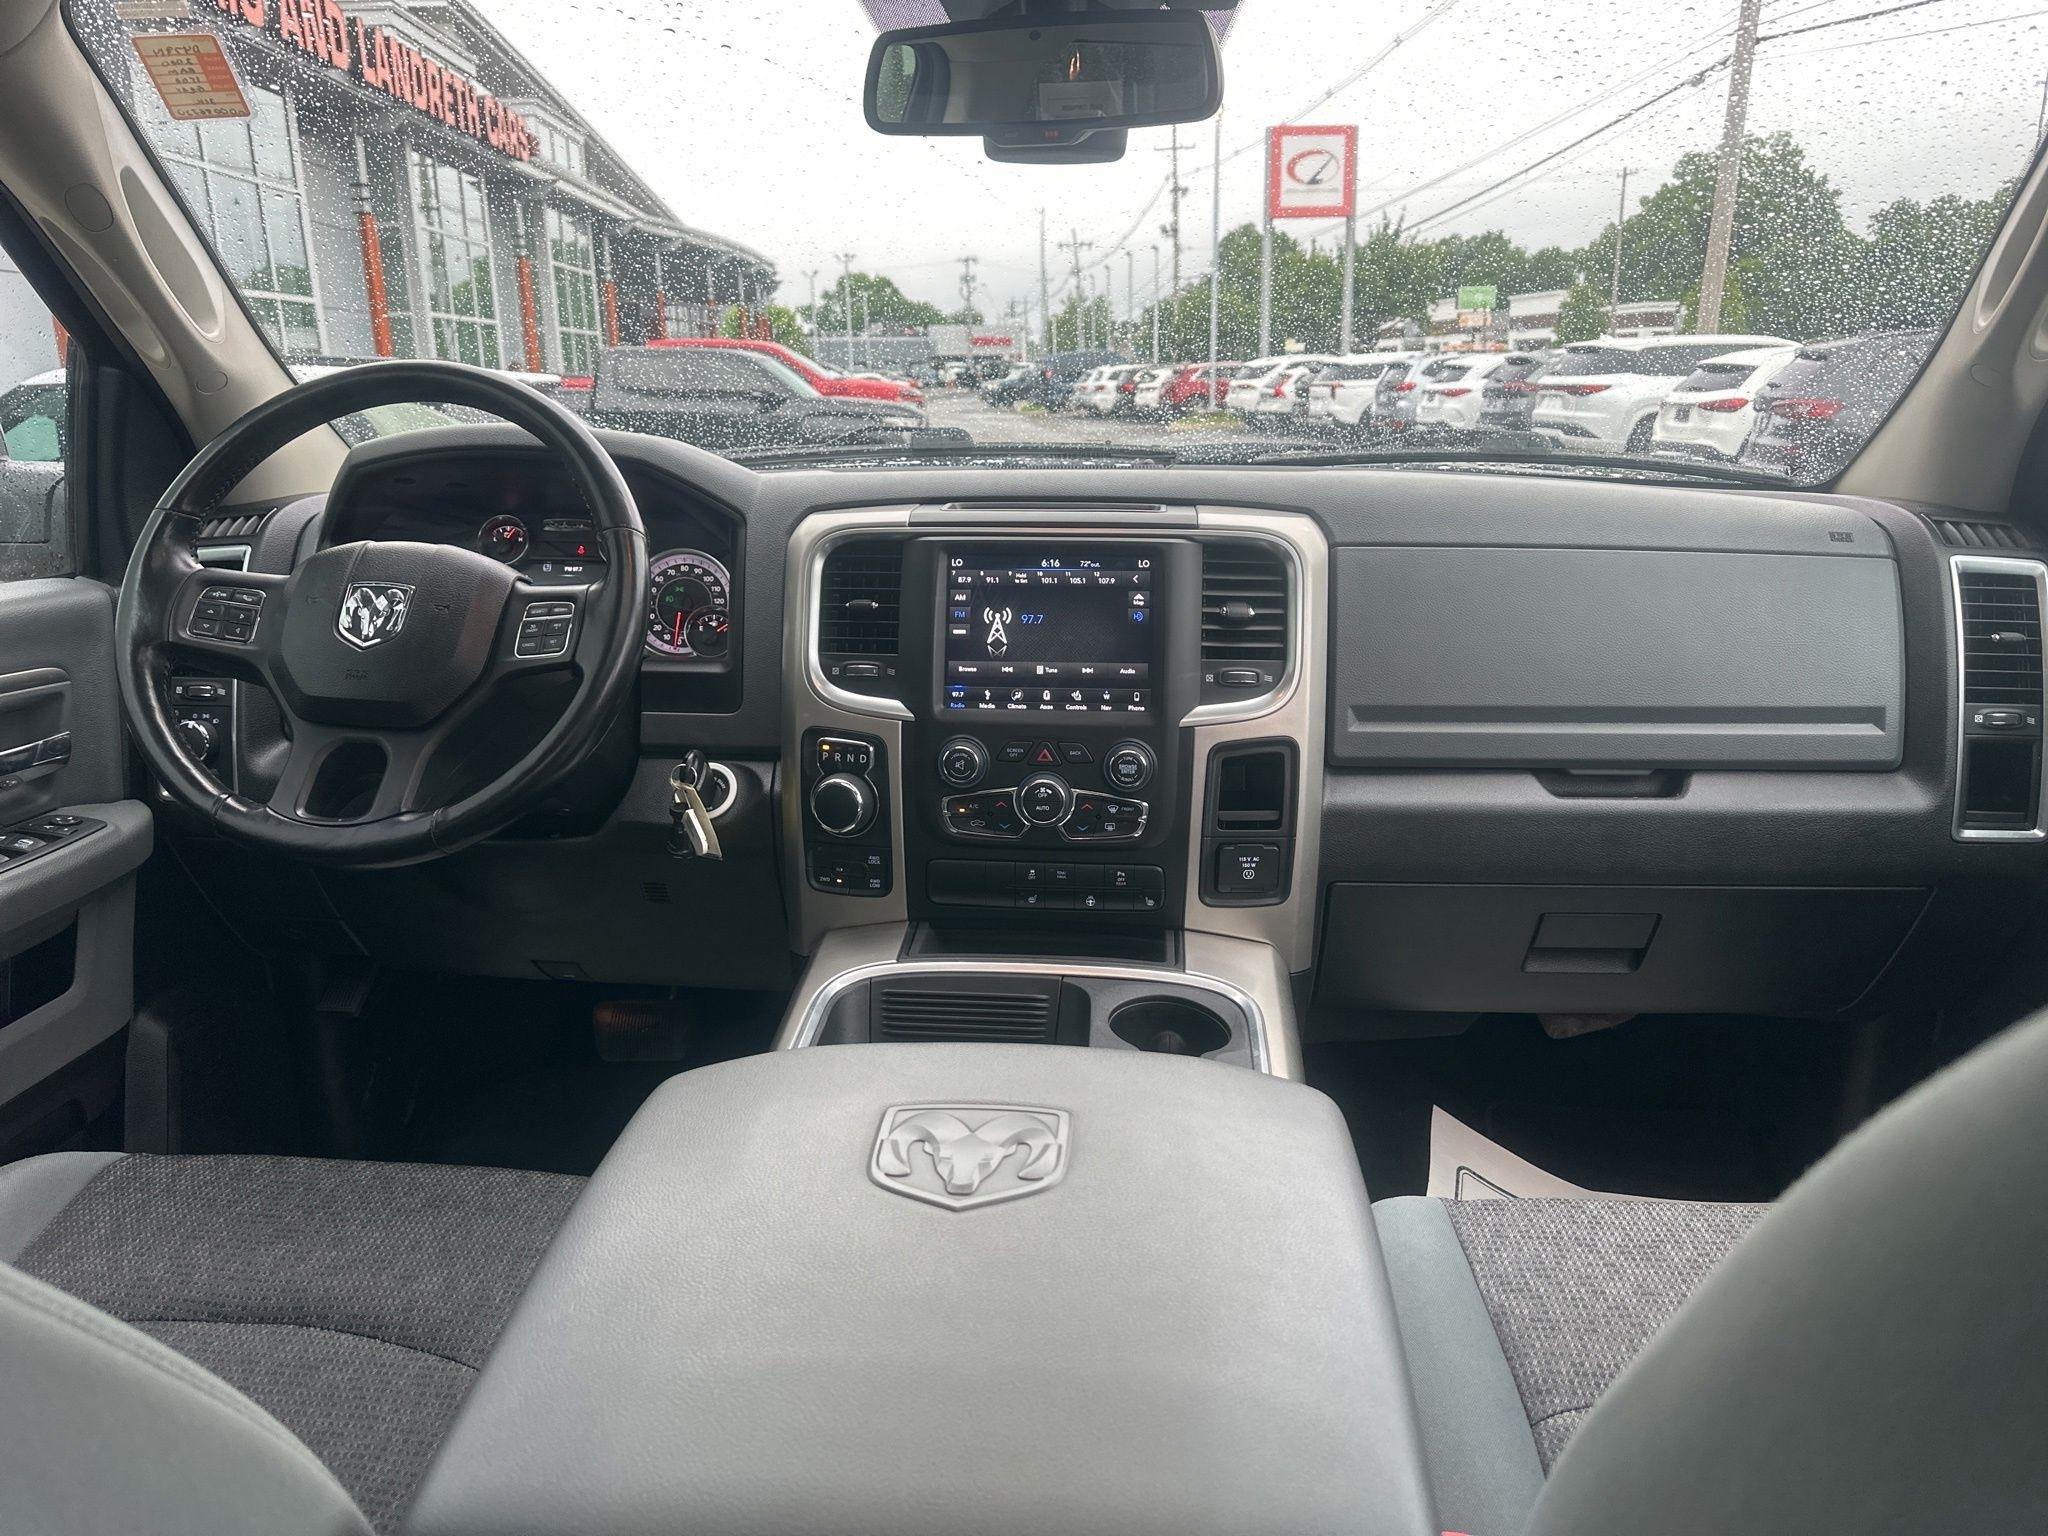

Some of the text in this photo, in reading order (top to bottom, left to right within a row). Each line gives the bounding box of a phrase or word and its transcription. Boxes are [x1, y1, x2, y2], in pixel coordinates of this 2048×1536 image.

[280, 0, 530, 162] AND LANDRETH CARS
[951, 558, 963, 567] LO
[1041, 559, 1060, 567] 6:16
[1021, 615, 1043, 624] 97.7
